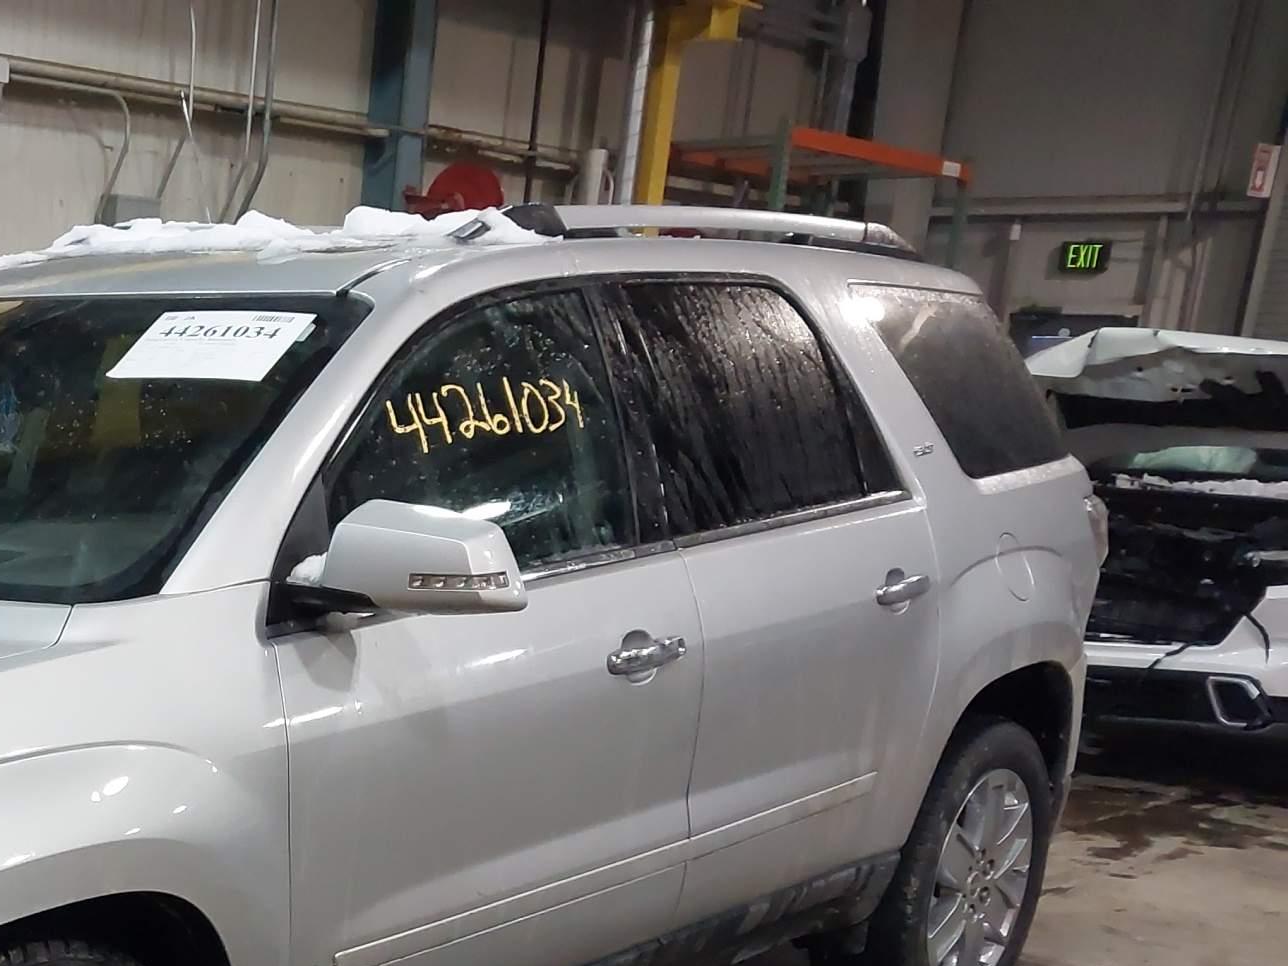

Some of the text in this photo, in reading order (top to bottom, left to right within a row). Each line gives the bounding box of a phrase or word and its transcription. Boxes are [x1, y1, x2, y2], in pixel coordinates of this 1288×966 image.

[1067, 244, 1104, 268] EXIT
[159, 324, 281, 340] 44261034
[385, 376, 584, 454] 44261034
